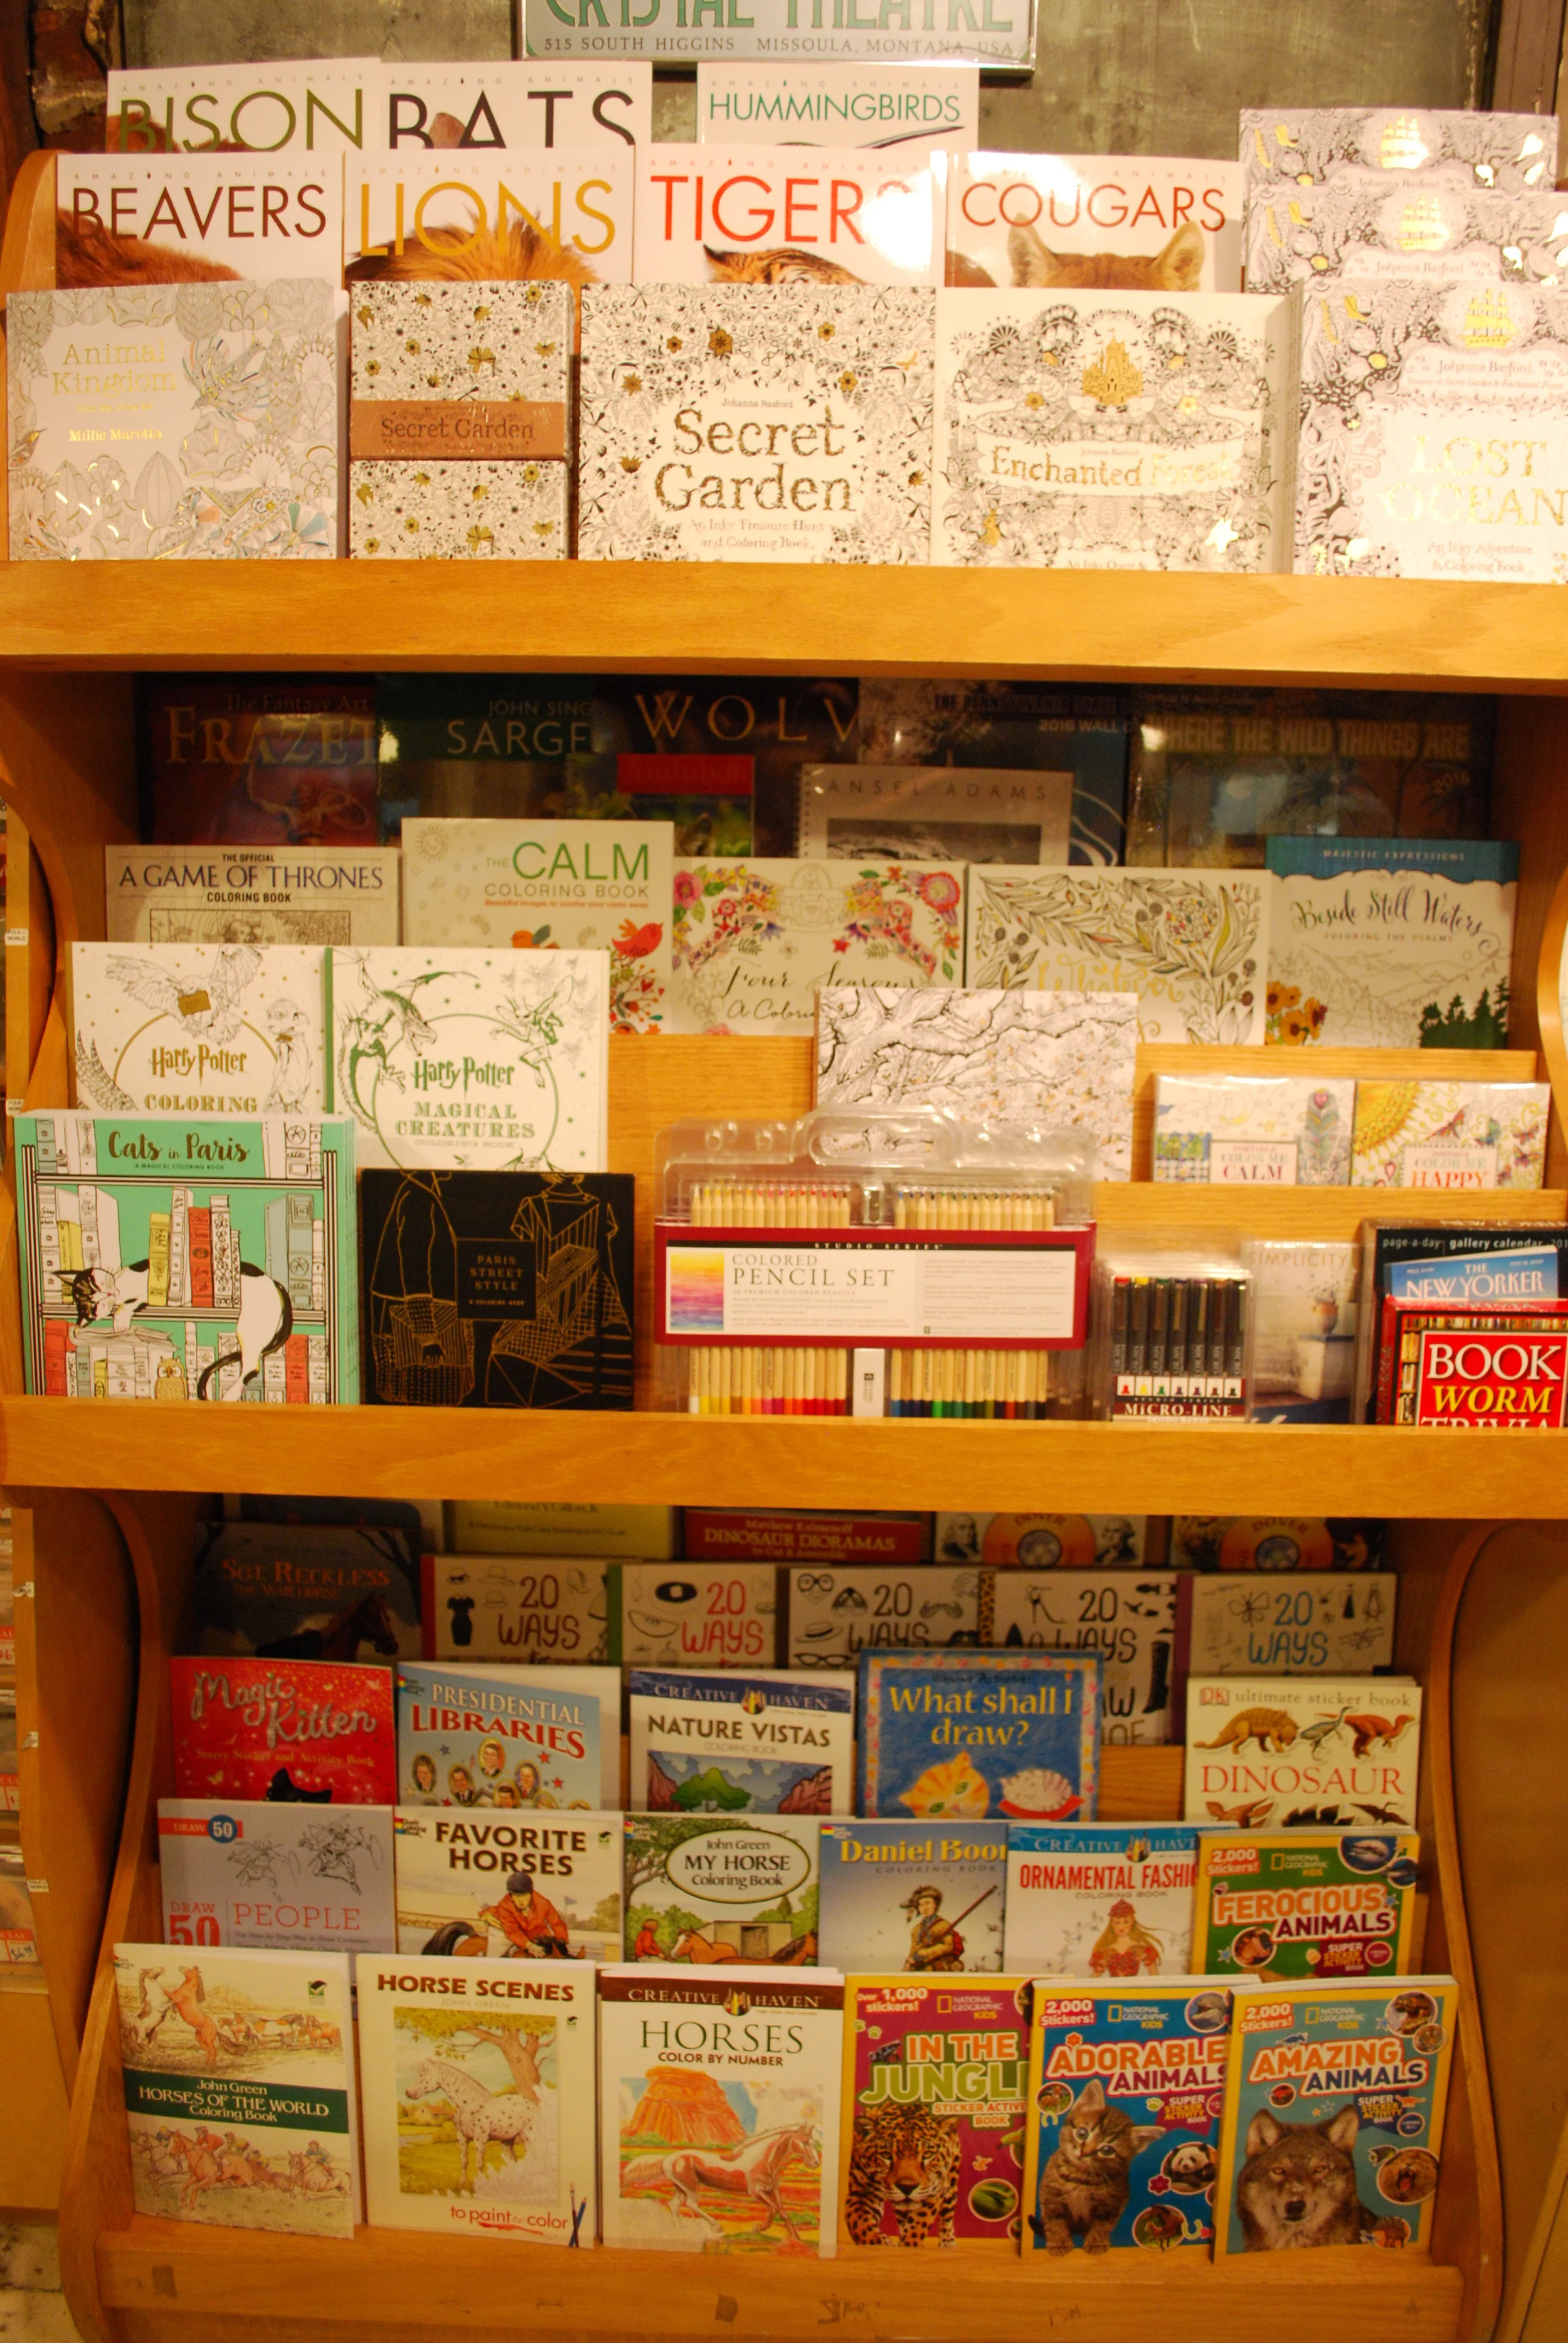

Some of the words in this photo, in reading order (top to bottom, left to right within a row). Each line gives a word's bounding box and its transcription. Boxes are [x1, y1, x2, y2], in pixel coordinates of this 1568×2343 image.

[544, 38, 572, 51] 515
[581, 37, 644, 51] SOUTH
[655, 37, 735, 51] HIGGINS
[757, 37, 859, 53] MISSOULA,
[866, 38, 963, 55] MONTANA
[978, 41, 1013, 55] USA
[527, 76, 633, 84] ANIMALS
[710, 93, 960, 122] HUMMINGBIRDS
[120, 88, 363, 152] BISON
[217, 169, 326, 179] ANIMALS
[72, 184, 327, 240] BEAVERS
[361, 179, 615, 256] LIONS
[961, 182, 1226, 231] COUGARS
[61, 339, 166, 366] Animal
[1436, 360, 1486, 375] Johanna
[1488, 361, 1533, 375] Basford
[51, 370, 177, 398] Kingdom
[721, 398, 758, 407] Johanna
[69, 428, 107, 442] Millie
[109, 428, 163, 441] Marotta
[381, 414, 450, 438] Secret
[454, 418, 534, 439] Garden
[674, 405, 844, 457] Secret
[991, 444, 1143, 486] Enchanted
[1152, 450, 1232, 486] Forest
[1409, 435, 1547, 477] LOST
[655, 462, 856, 512] Garden
[1380, 482, 1568, 526] OCEAN
[709, 518, 737, 533] Inky
[740, 518, 789, 531] Treasure
[793, 519, 824, 532] Hunt
[726, 535, 777, 550] Coloring
[781, 536, 810, 549] Book
[263, 694, 331, 713] Fantasy
[338, 694, 369, 711] Art
[489, 701, 538, 717] JOHN
[1232, 718, 1271, 750] THE
[1276, 718, 1333, 751] WILD
[1340, 720, 1418, 753] THINGS
[1425, 721, 1471, 758] ARE
[827, 778, 920, 797] ANSEL
[944, 782, 1046, 800] ADAMS
[222, 854, 237, 862] THE
[240, 854, 275, 863] OFFICIAL
[485, 856, 509, 868] THE
[512, 841, 649, 881] CALM
[1323, 849, 1378, 859] MAJESTIC
[1385, 851, 1466, 861] EXPRESSIONS
[119, 866, 137, 887] A
[143, 864, 220, 888] GAME
[226, 865, 258, 888] OF
[267, 865, 383, 890] THRONES
[207, 891, 260, 903] COLORING
[263, 892, 291, 903] BOOK
[484, 883, 586, 898] COLORING
[595, 883, 649, 898] BOOK
[1291, 889, 1358, 933] Beside
[1367, 884, 1416, 925] Still
[1423, 888, 1484, 937] Waters
[724, 958, 793, 999] Four
[149, 1046, 196, 1078] Harry
[196, 1044, 247, 1087] Potter
[411, 1059, 461, 1091] Harry
[462, 1056, 515, 1099] Potter
[144, 1093, 258, 1113] COLORING
[413, 1101, 517, 1120] MAGICAL
[395, 1120, 535, 1139] CREATURES
[108, 1130, 161, 1162] Cats
[168, 1145, 181, 1159] in
[186, 1132, 250, 1163] Paris
[414, 1139, 478, 1148] COLORING
[482, 1140, 515, 1149] BOOK
[1221, 1153, 1264, 1163] COLOR
[1269, 1153, 1288, 1164] ME
[1414, 1157, 1458, 1167] COLOR
[1223, 1164, 1283, 1180] CALM
[1411, 1170, 1488, 1187] HAPPY
[1382, 1238, 1441, 1249] page-a-day
[1449, 1237, 1491, 1250] gallery
[1493, 1238, 1543, 1248] calendar
[477, 1255, 516, 1265] PARIS
[732, 1254, 818, 1266] COLORED
[1464, 1263, 1488, 1274] THE
[470, 1267, 524, 1278] STREET
[733, 1268, 835, 1285] PENCIL
[847, 1268, 895, 1287] SET
[1406, 1277, 1456, 1299] NEW
[1459, 1270, 1544, 1297] YORKER
[474, 1280, 519, 1291] STYLE
[1426, 1344, 1562, 1380] BOOK
[1124, 1403, 1232, 1417] MICRO-LINE
[1433, 1384, 1554, 1413] WORM
[744, 1517, 792, 1531] Matthew
[704, 1528, 795, 1549] DINOSAUR
[800, 1533, 896, 1552] DIORAMAS
[274, 1561, 390, 1587] RECKLESS
[519, 1573, 559, 1610] 20
[706, 1580, 746, 1616] 20
[872, 1582, 913, 1617] 20
[1078, 1588, 1120, 1623] 20
[1274, 1591, 1314, 1627] 20
[497, 1613, 580, 1650] WAYS
[681, 1619, 765, 1655] WAYS
[847, 1622, 930, 1653] WAYS
[1248, 1630, 1329, 1667] WAYS
[190, 1671, 295, 1726] Magic
[432, 1683, 585, 1726] PRESIDENTIAL
[654, 1686, 738, 1703] CREATIVE
[770, 1692, 829, 1711] HAVEN
[889, 1685, 978, 1713] What
[982, 1686, 1057, 1714] shall
[1064, 1689, 1072, 1714] I
[1200, 1687, 1229, 1706] DK
[1235, 1689, 1301, 1704] ultimate
[1307, 1690, 1362, 1706] sticker
[1369, 1692, 1411, 1707] book
[267, 1700, 376, 1749] Kitten
[411, 1704, 585, 1759] LIBRARIES
[647, 1714, 743, 1740] NATURE
[750, 1723, 830, 1748] VISTAS
[931, 1717, 1030, 1746] draw?
[1200, 1765, 1406, 1795] DINOSAUR
[173, 1823, 206, 1833] DRAW
[212, 1820, 234, 1839] 50
[435, 1821, 587, 1852] FAVORITE
[706, 1839, 733, 1851] John
[735, 1839, 771, 1851] Green
[840, 1839, 933, 1863] Daniel
[1034, 1838, 1123, 1852] CREATIVE
[1212, 1848, 1257, 1864] 2,000
[448, 1847, 574, 1876] HORSES
[684, 1854, 718, 1871] MY
[724, 1854, 791, 1871] HORSE
[1207, 1860, 1259, 1876] Stickers!
[691, 1873, 749, 1891] Coloring
[750, 1873, 783, 1886] Book
[1020, 1863, 1136, 1890] ORNAMENTAL
[170, 1901, 216, 1913] DRAW
[1216, 1887, 1384, 1921] FEROCIOUS
[235, 1903, 361, 1931] PEOPLE
[1276, 1912, 1391, 1938] ANIMALS
[169, 1914, 221, 1946] 50
[1327, 1942, 1364, 1952] SUPER
[378, 1974, 467, 1995] HORSE
[475, 1979, 575, 2002] SCENES
[628, 1988, 721, 2005] CREATIVE
[755, 1995, 820, 2007] HAVEN
[857, 1993, 878, 2001] Over
[881, 1988, 928, 2002] 1,000
[442, 1999, 471, 2007] JOHN
[474, 2000, 510, 2009] GREEN
[866, 2000, 919, 2013] stickers!
[1046, 1999, 1093, 2015] 2,000
[1246, 2004, 1291, 2020] 2,000
[1040, 2012, 1096, 2026] Stickers!
[1140, 2021, 1163, 2029] KIDS
[1239, 2016, 1293, 2032] Stickers!
[1337, 2021, 1360, 2030] KIDS
[640, 2019, 803, 2054] HORSES
[906, 2034, 944, 2063] IN
[948, 2032, 1019, 2061] THE
[658, 2051, 703, 2063] COLOR
[707, 2054, 724, 2064] BY
[728, 2054, 784, 2066] NUMBER
[1051, 2038, 1227, 2073] ADORABLE
[1254, 2040, 1399, 2078] AMAZING
[196, 2079, 228, 2091] John
[229, 2082, 268, 2095] Green
[1113, 2064, 1227, 2091] ANIMALS
[1305, 2063, 1424, 2092] ANIMALS
[139, 2086, 204, 2105] HORSES
[207, 2093, 230, 2108] OF
[231, 2096, 266, 2111] THE
[268, 2100, 329, 2117] WORLD
[934, 2102, 984, 2113] STICKER
[1169, 2095, 1205, 2105] SUPER
[1357, 2095, 1394, 2105] SUPER
[189, 2104, 243, 2122] Coloring
[245, 2110, 278, 2123] Book
[974, 2115, 1009, 2126] BOOK
[450, 2205, 466, 2219] to
[469, 2208, 511, 2224] paint
[526, 2210, 569, 2229] color
